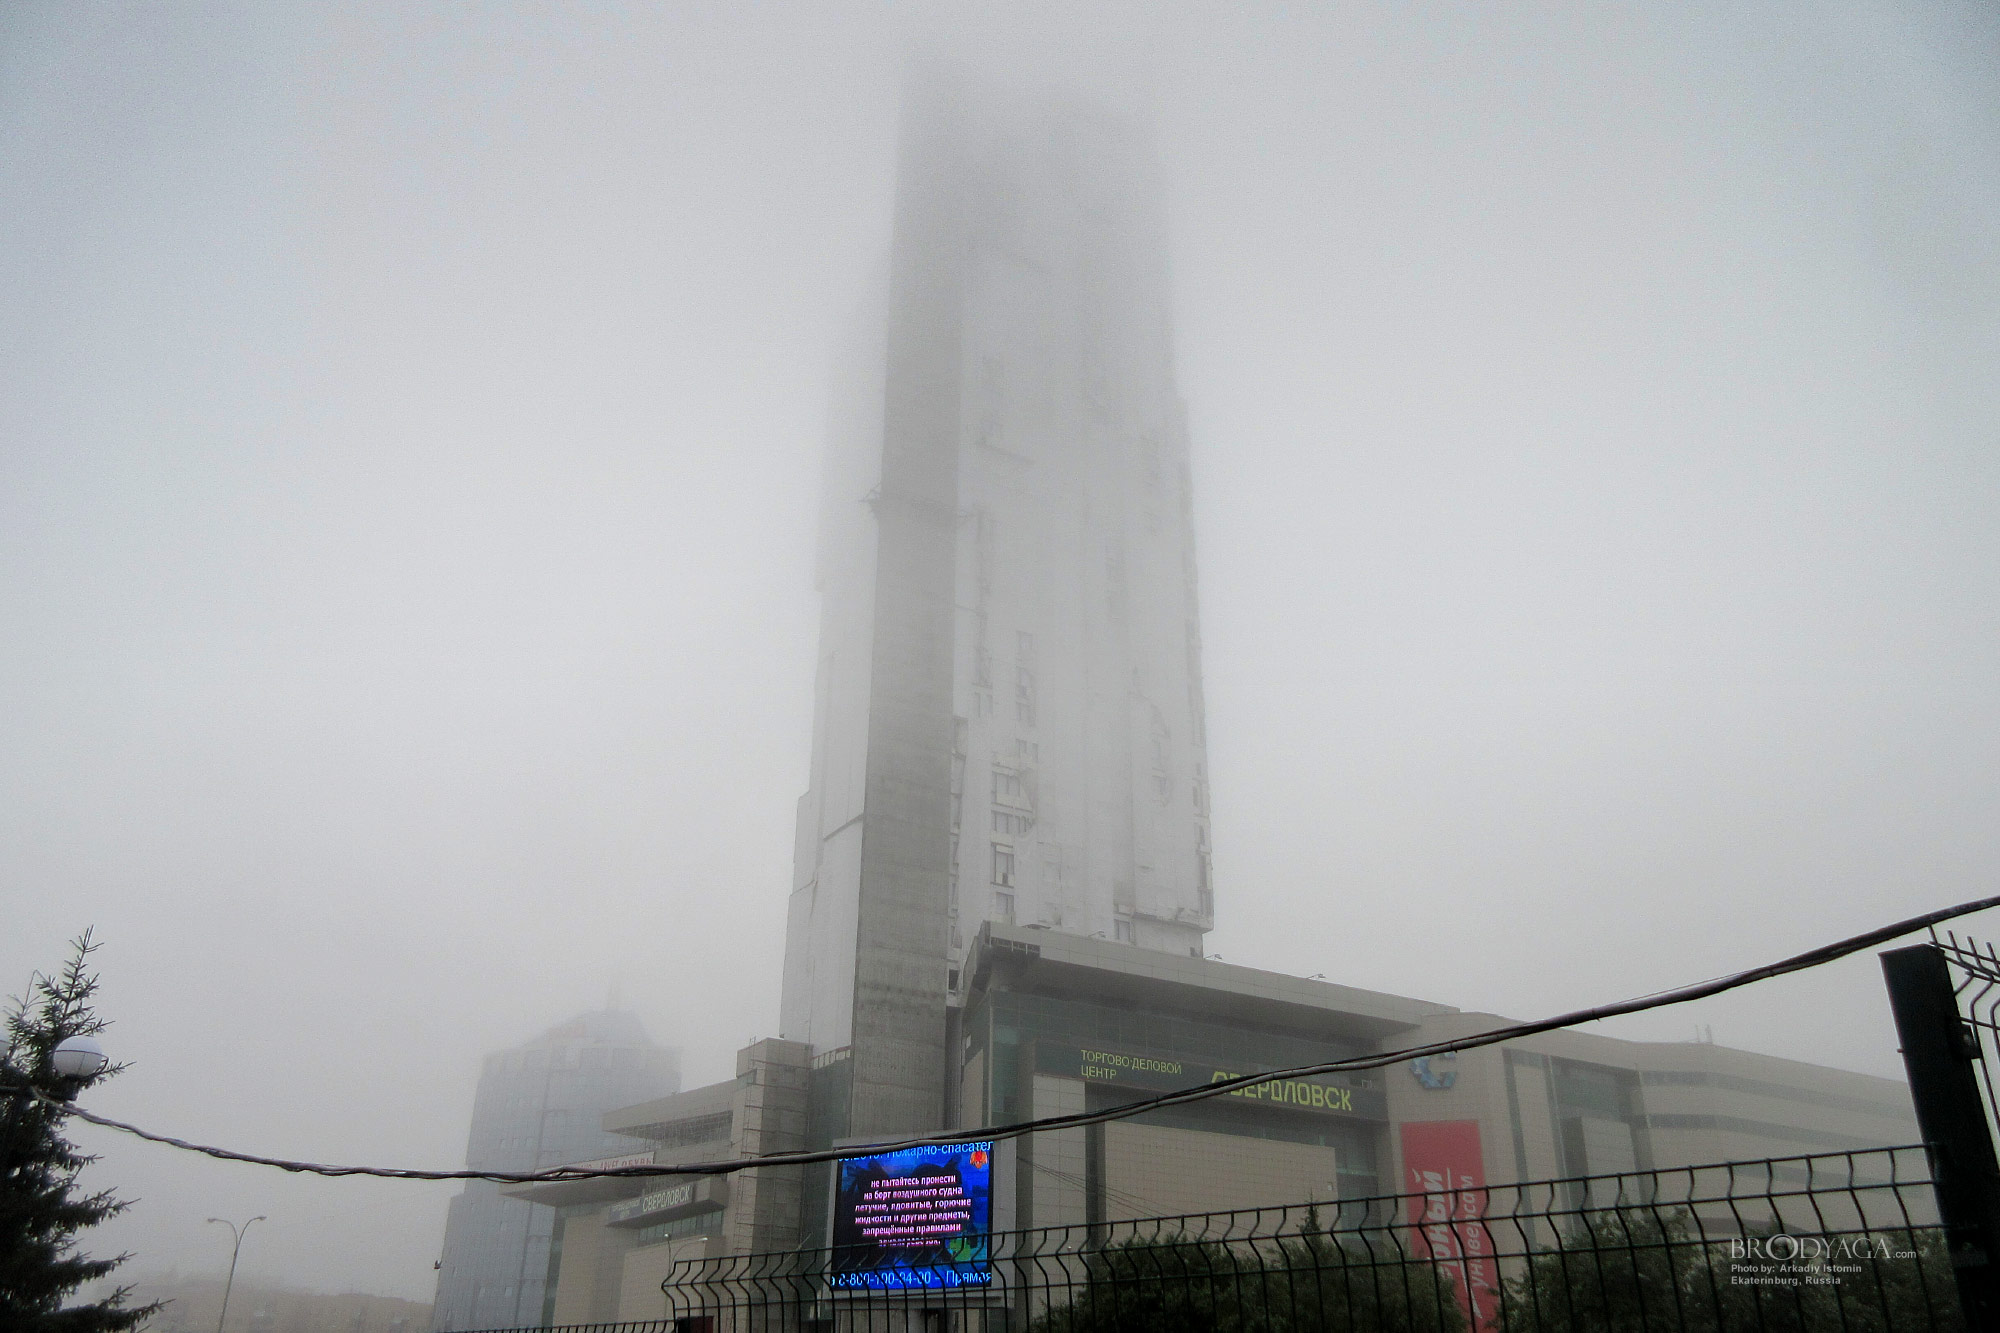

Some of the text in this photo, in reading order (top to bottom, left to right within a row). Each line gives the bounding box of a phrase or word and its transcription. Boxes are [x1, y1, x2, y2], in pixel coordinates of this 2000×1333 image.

[1081, 1065, 1117, 1079] ЦЕНТР
[871, 1175, 956, 1188] не пытайтесь пронести
[642, 1185, 690, 1212] СВЕРДЛОВСК
[864, 1186, 963, 1201] на борт воздушного судна
[935, 1198, 971, 1210] горючие
[855, 1215, 891, 1224] жидкости
[900, 1214, 927, 1224] другие
[916, 1223, 961, 1235] правилами
[946, 1270, 992, 1286] Прямая
